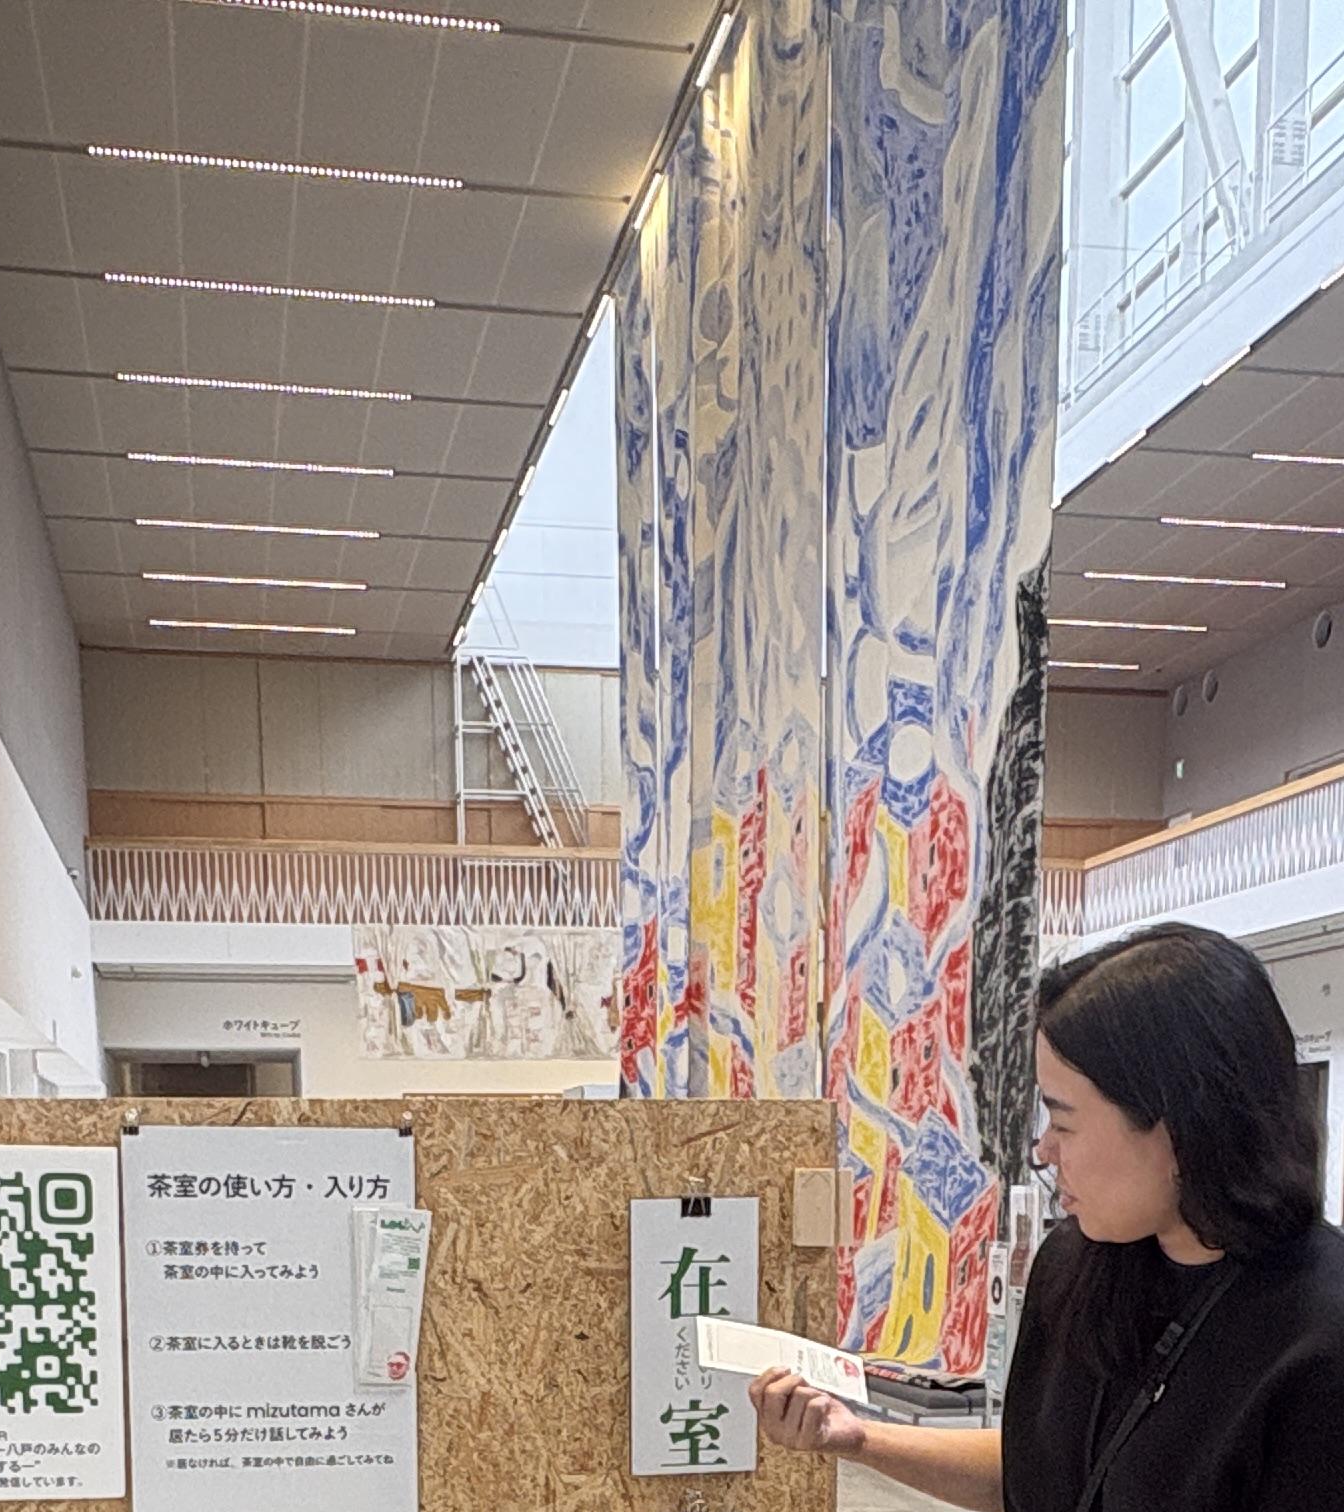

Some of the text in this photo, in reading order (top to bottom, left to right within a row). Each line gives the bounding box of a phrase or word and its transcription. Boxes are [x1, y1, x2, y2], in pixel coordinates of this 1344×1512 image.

[222, 1019, 302, 1032] ホワイトキューブ
[147, 1173, 391, 1200] 茶室の使い方・入り方
[163, 1264, 320, 1280] 茶室の中に入ってみよう
[246, 1402, 341, 1418] mizutama
[344, 1401, 387, 1418] さんが
